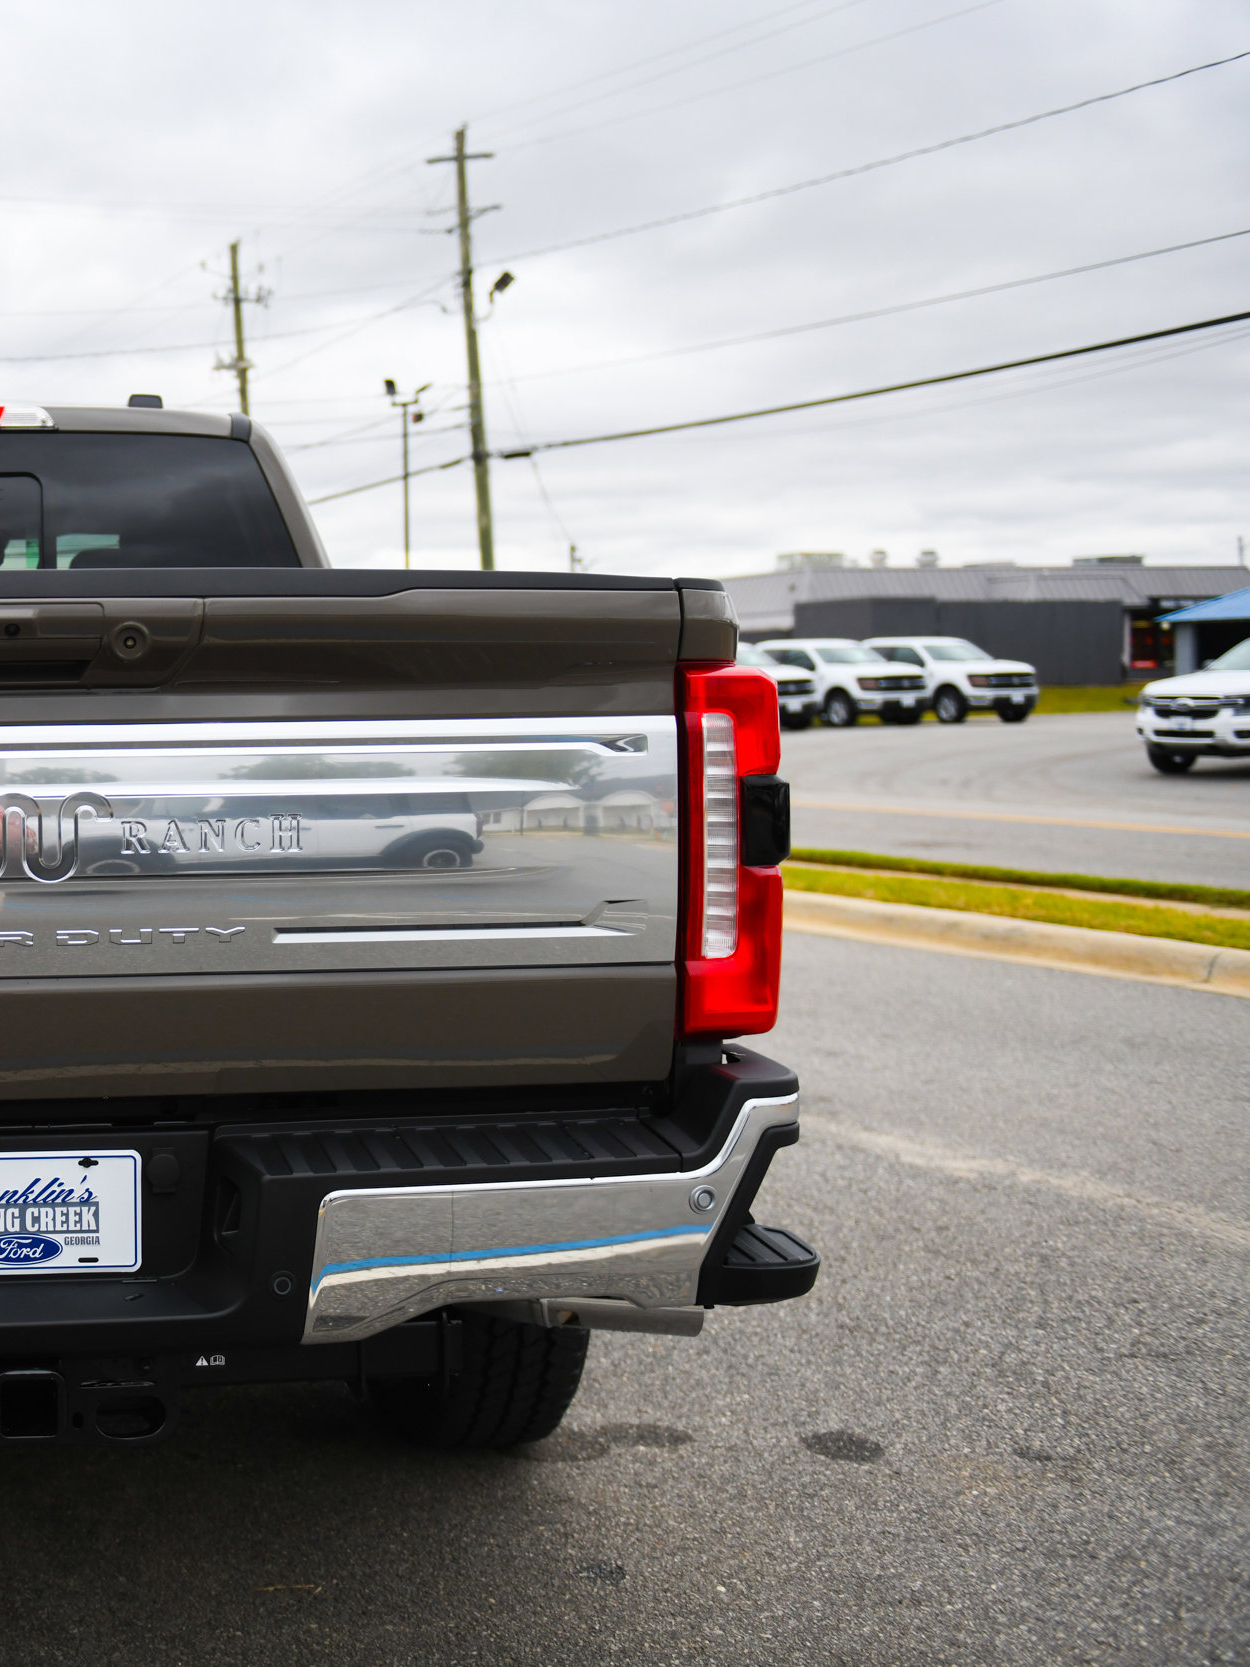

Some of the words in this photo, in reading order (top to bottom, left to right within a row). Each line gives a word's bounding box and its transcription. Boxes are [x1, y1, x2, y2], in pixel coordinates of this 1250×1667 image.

[119, 811, 305, 855] RANCH
[55, 925, 246, 948] DUTY
[25, 1206, 97, 1232] CREEK
[64, 1236, 101, 1246] GEORGIA
